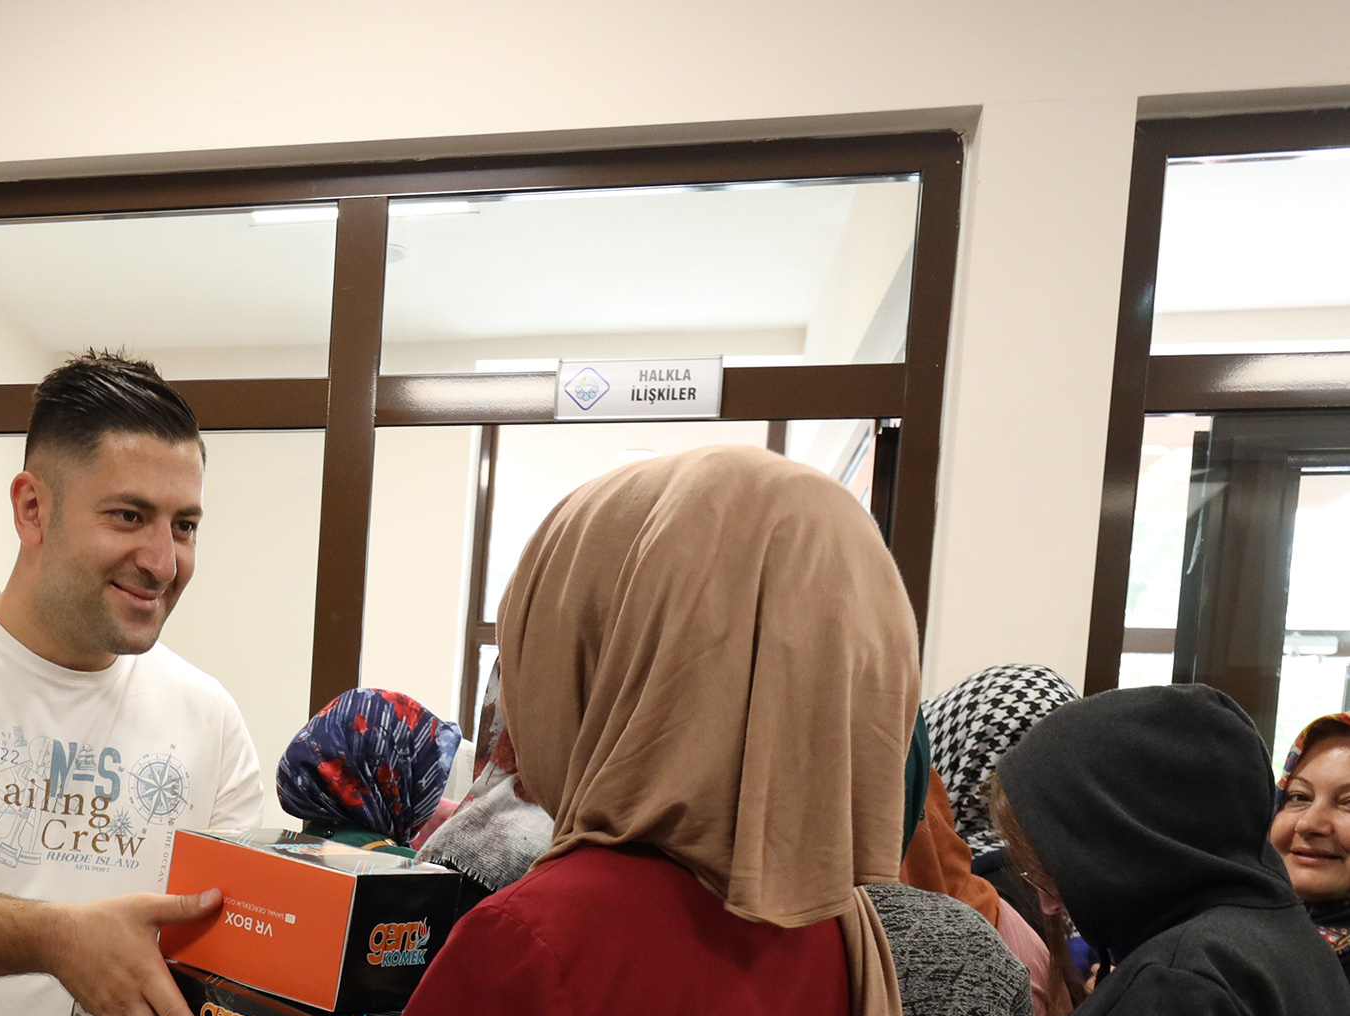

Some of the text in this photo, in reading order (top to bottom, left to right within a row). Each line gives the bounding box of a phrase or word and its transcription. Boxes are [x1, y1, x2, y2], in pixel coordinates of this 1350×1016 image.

[639, 369, 691, 382] HALKLA
[631, 385, 696, 405] İLİŞKİLER
[41, 818, 146, 858] Crew
[164, 831, 173, 849] THE
[46, 851, 140, 870] RHODE ISLAND
[75, 864, 111, 873] NEWPORT
[224, 910, 273, 937] VR BOX
[381, 948, 428, 967] KOMEK
